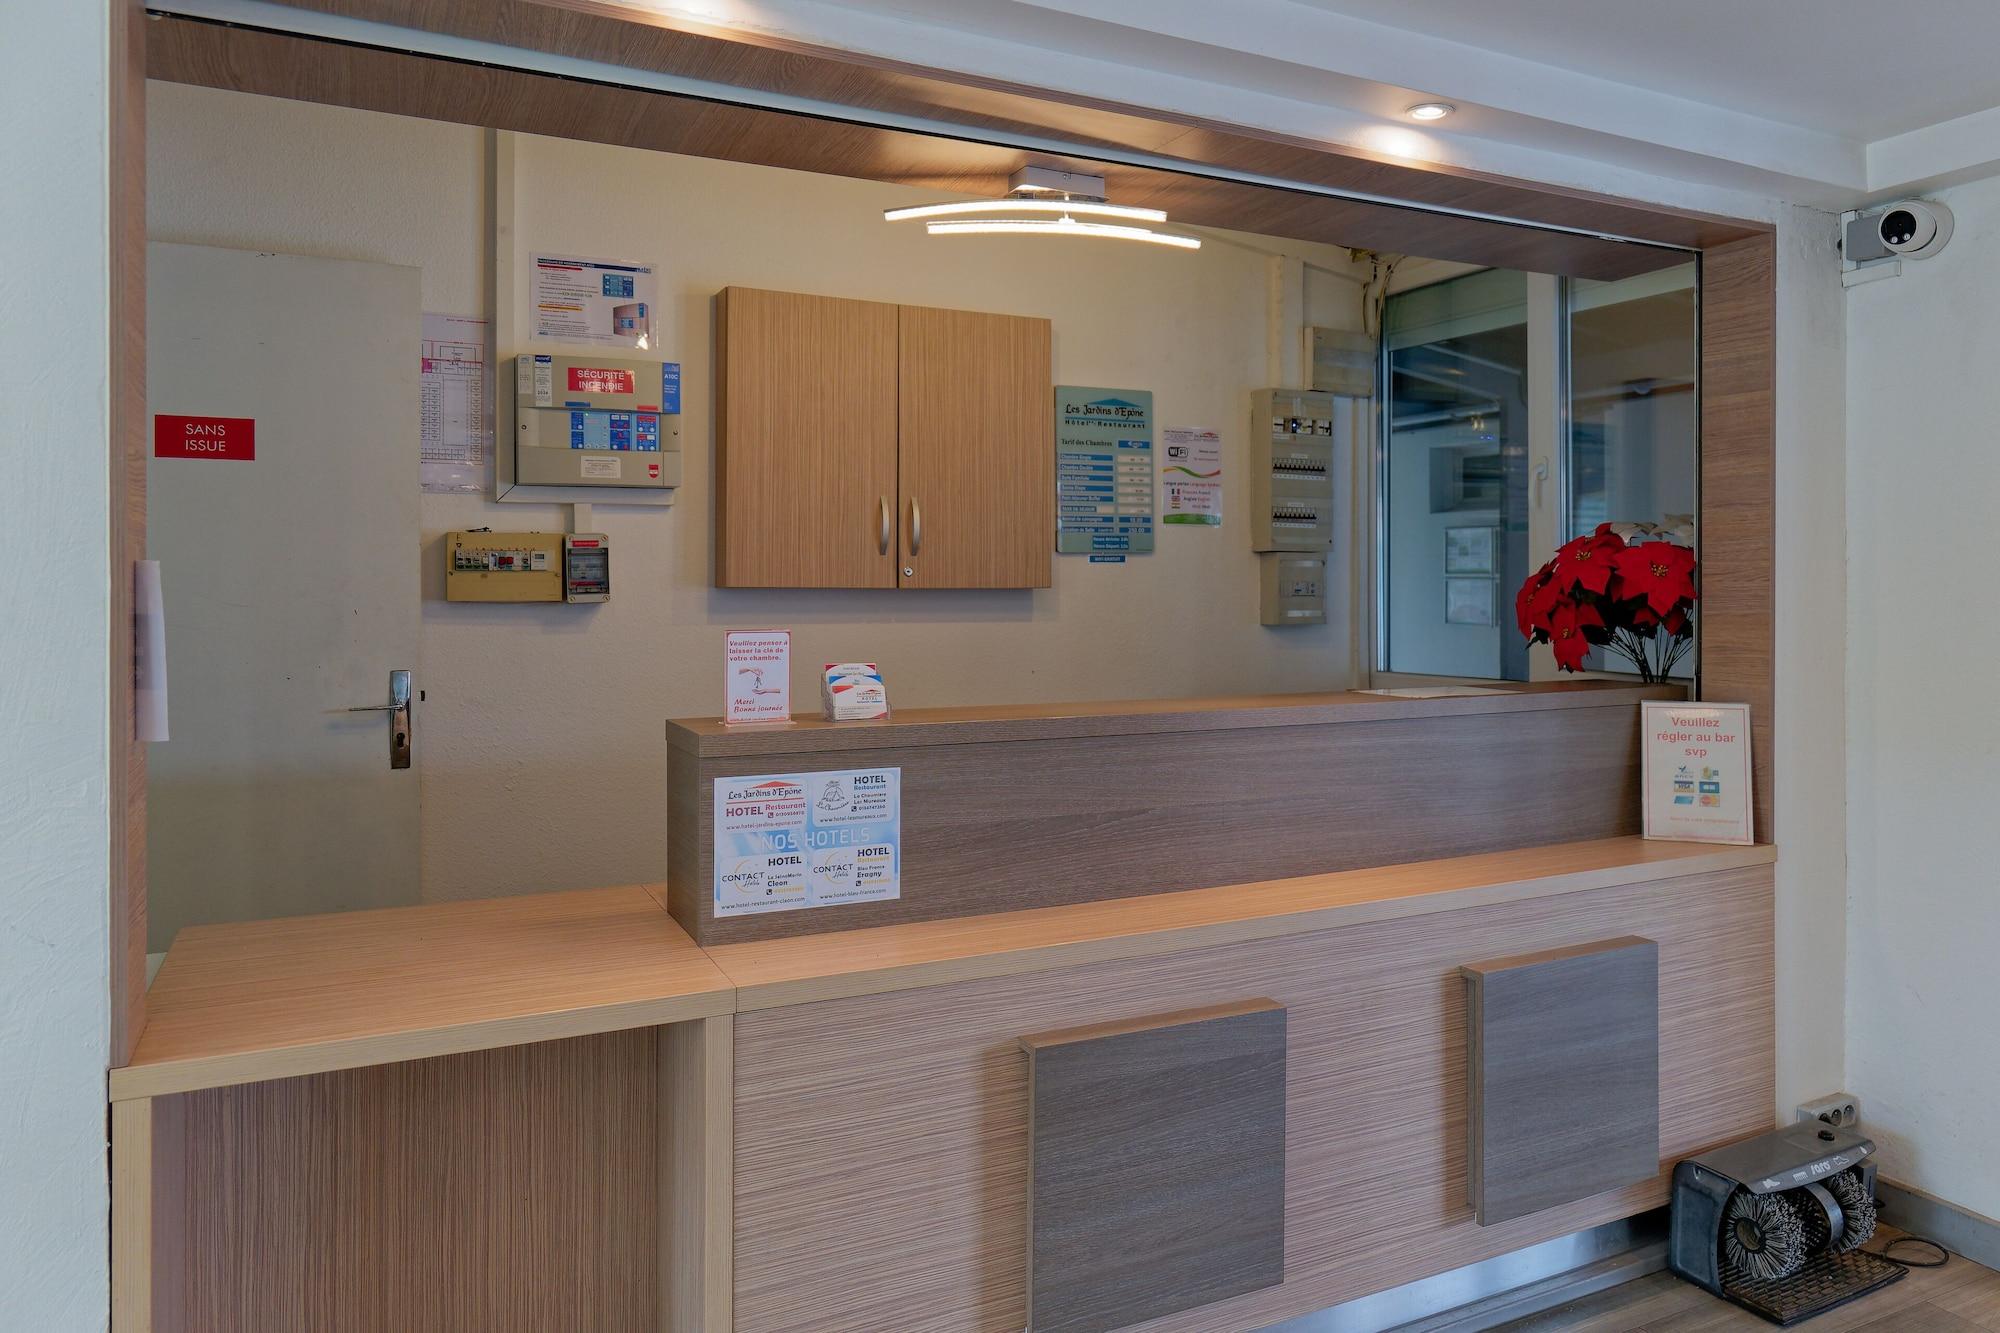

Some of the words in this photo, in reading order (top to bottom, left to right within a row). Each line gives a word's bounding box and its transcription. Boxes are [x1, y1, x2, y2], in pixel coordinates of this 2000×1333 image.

[577, 368, 625, 380] SÉCURITÉ
[578, 380, 624, 392] INCENDIE
[1064, 404, 1080, 414] Les
[1082, 404, 1112, 416] Jardins
[185, 423, 226, 436] SANS
[185, 440, 226, 452] ISSUE
[1672, 717, 1720, 728] Veuillez
[1657, 731, 1692, 743] régler
[1696, 734, 1711, 742] au
[1716, 733, 1736, 742] bar
[1685, 748, 1707, 758] svp
[854, 776, 886, 784] HOTEL
[728, 792, 742, 800] Les
[744, 789, 770, 799] Jardins
[726, 806, 764, 817] HOTEL
[765, 802, 806, 811] Restaurant
[762, 833, 798, 850] NOS
[804, 827, 870, 847] HOTELS
[857, 848, 890, 856] HOTEL
[768, 856, 802, 866] HOTEL
[813, 864, 854, 874] CONTACT
[722, 872, 765, 882] CONTACT
